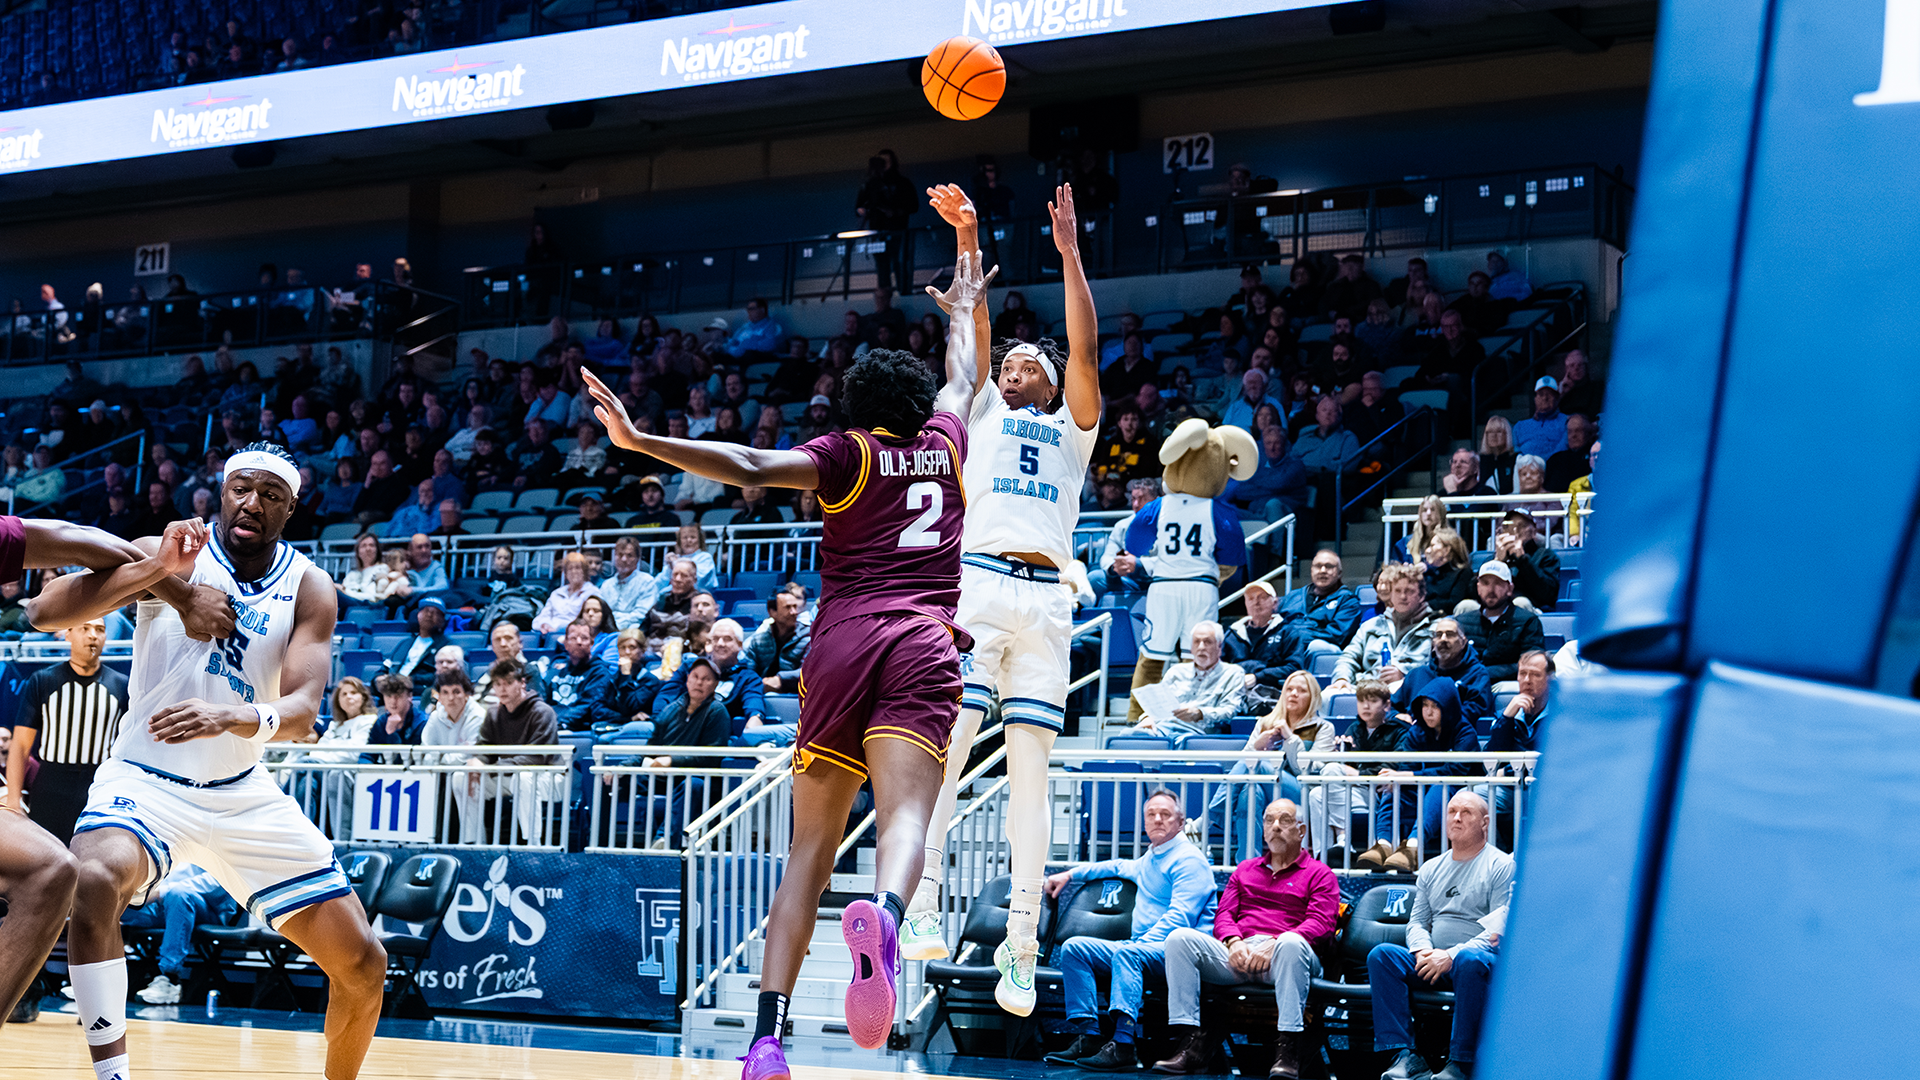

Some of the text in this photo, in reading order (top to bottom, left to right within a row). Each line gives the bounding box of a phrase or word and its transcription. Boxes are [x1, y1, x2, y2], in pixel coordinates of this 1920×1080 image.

[660, 24, 811, 77] Navigant
[392, 63, 527, 112] Navigant
[150, 97, 273, 143] Navigant
[1167, 136, 1210, 170] 212
[138, 247, 165, 272] 211
[1001, 417, 1063, 448] RHODE
[878, 449, 951, 477] OLA-JOSEPH
[1019, 443, 1040, 477] 5
[992, 477, 1059, 504] ISLAND
[896, 481, 944, 548] 2
[1164, 522, 1203, 557] 34
[366, 778, 421, 833] 111
[443, 965, 469, 990] of
[473, 953, 538, 997] Fresh
